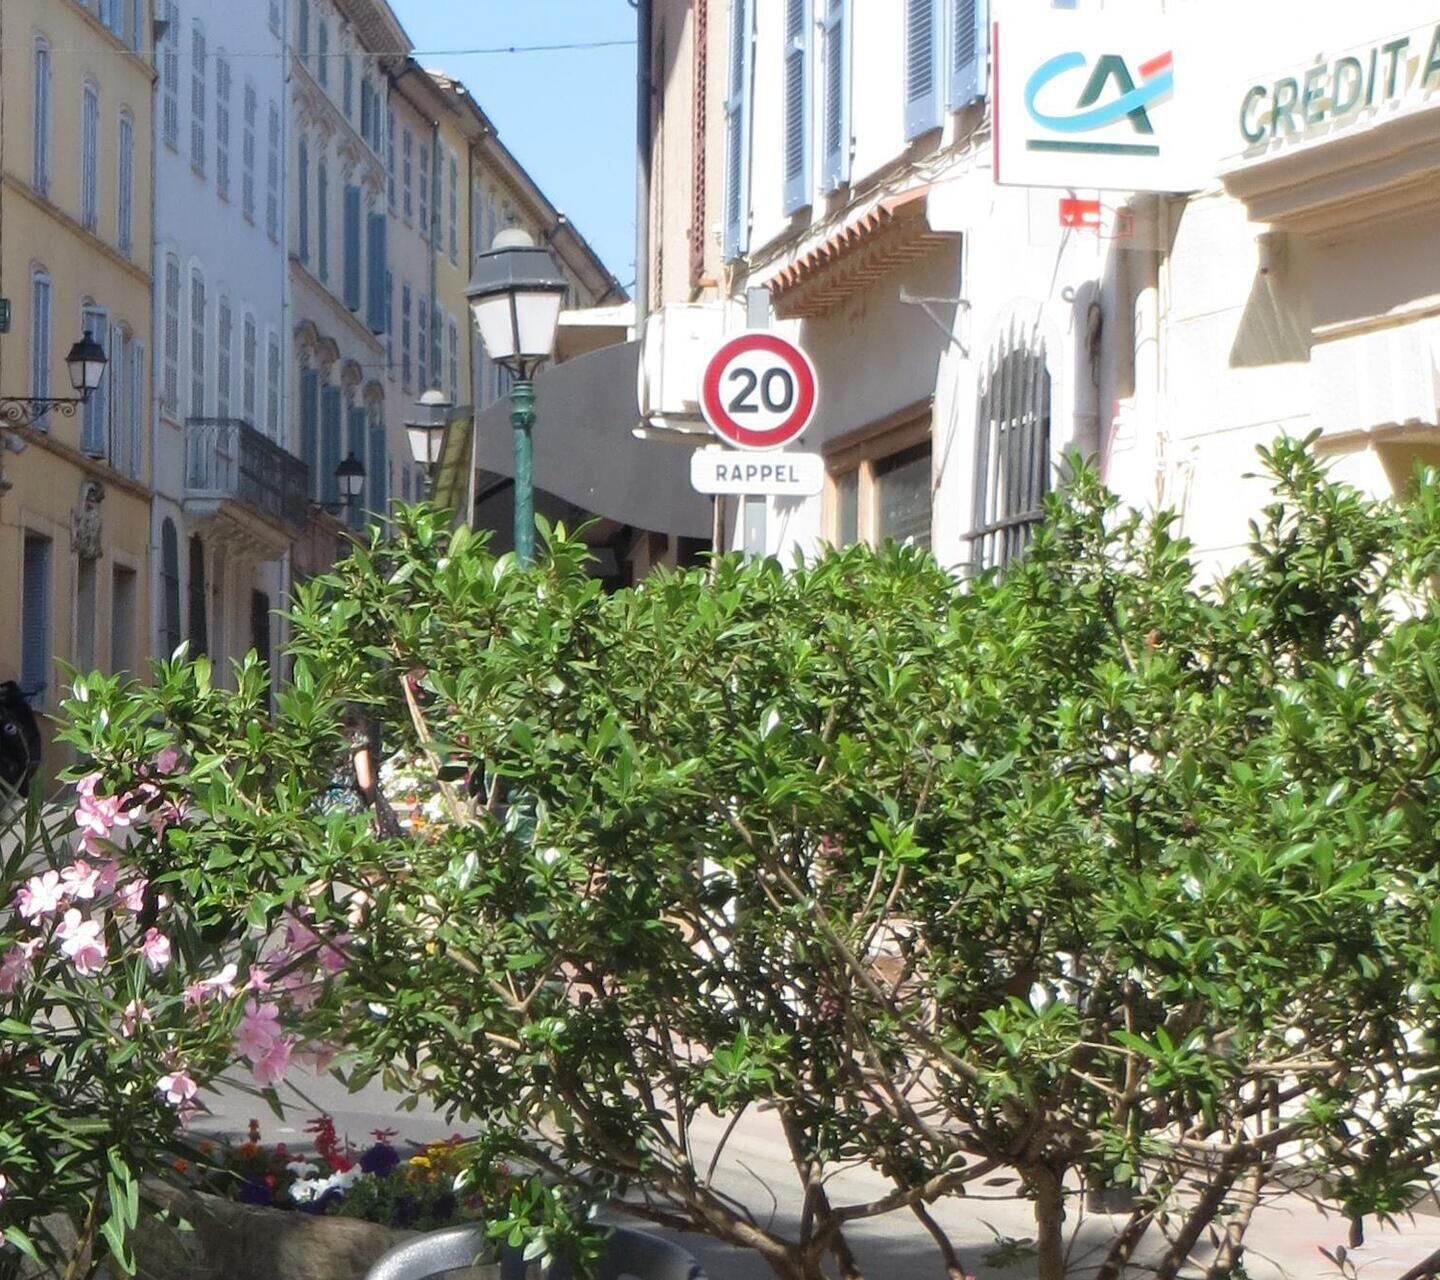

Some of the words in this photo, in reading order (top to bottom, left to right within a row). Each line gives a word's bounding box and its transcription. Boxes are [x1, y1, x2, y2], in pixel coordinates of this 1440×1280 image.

[1239, 35, 1410, 144] CRÉDIT
[728, 367, 795, 414] 20
[715, 464, 800, 483] RAPPEL
